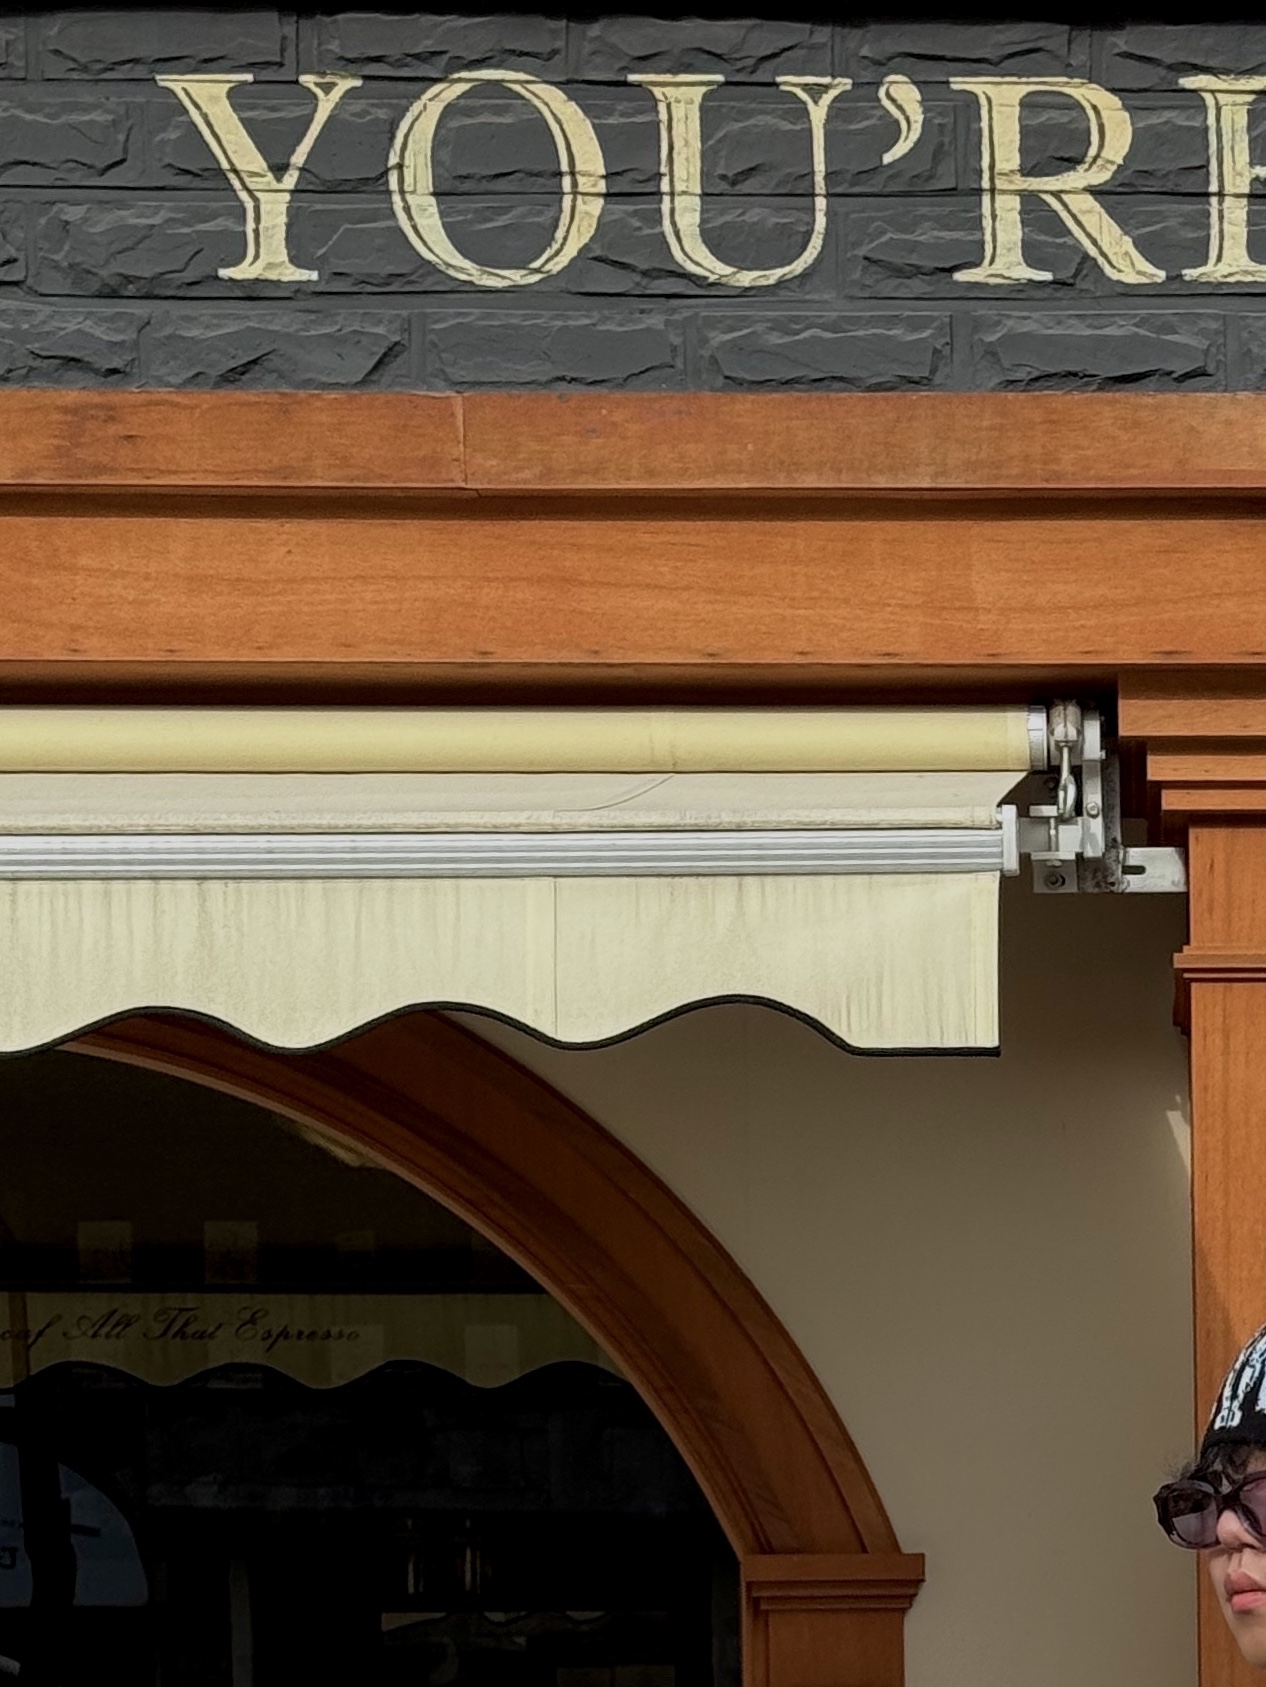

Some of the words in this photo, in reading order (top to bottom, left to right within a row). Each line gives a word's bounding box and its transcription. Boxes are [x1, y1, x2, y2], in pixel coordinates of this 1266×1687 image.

[62, 1308, 141, 1340] All
[142, 1306, 224, 1341] That
[235, 1306, 360, 1353] Espresso
